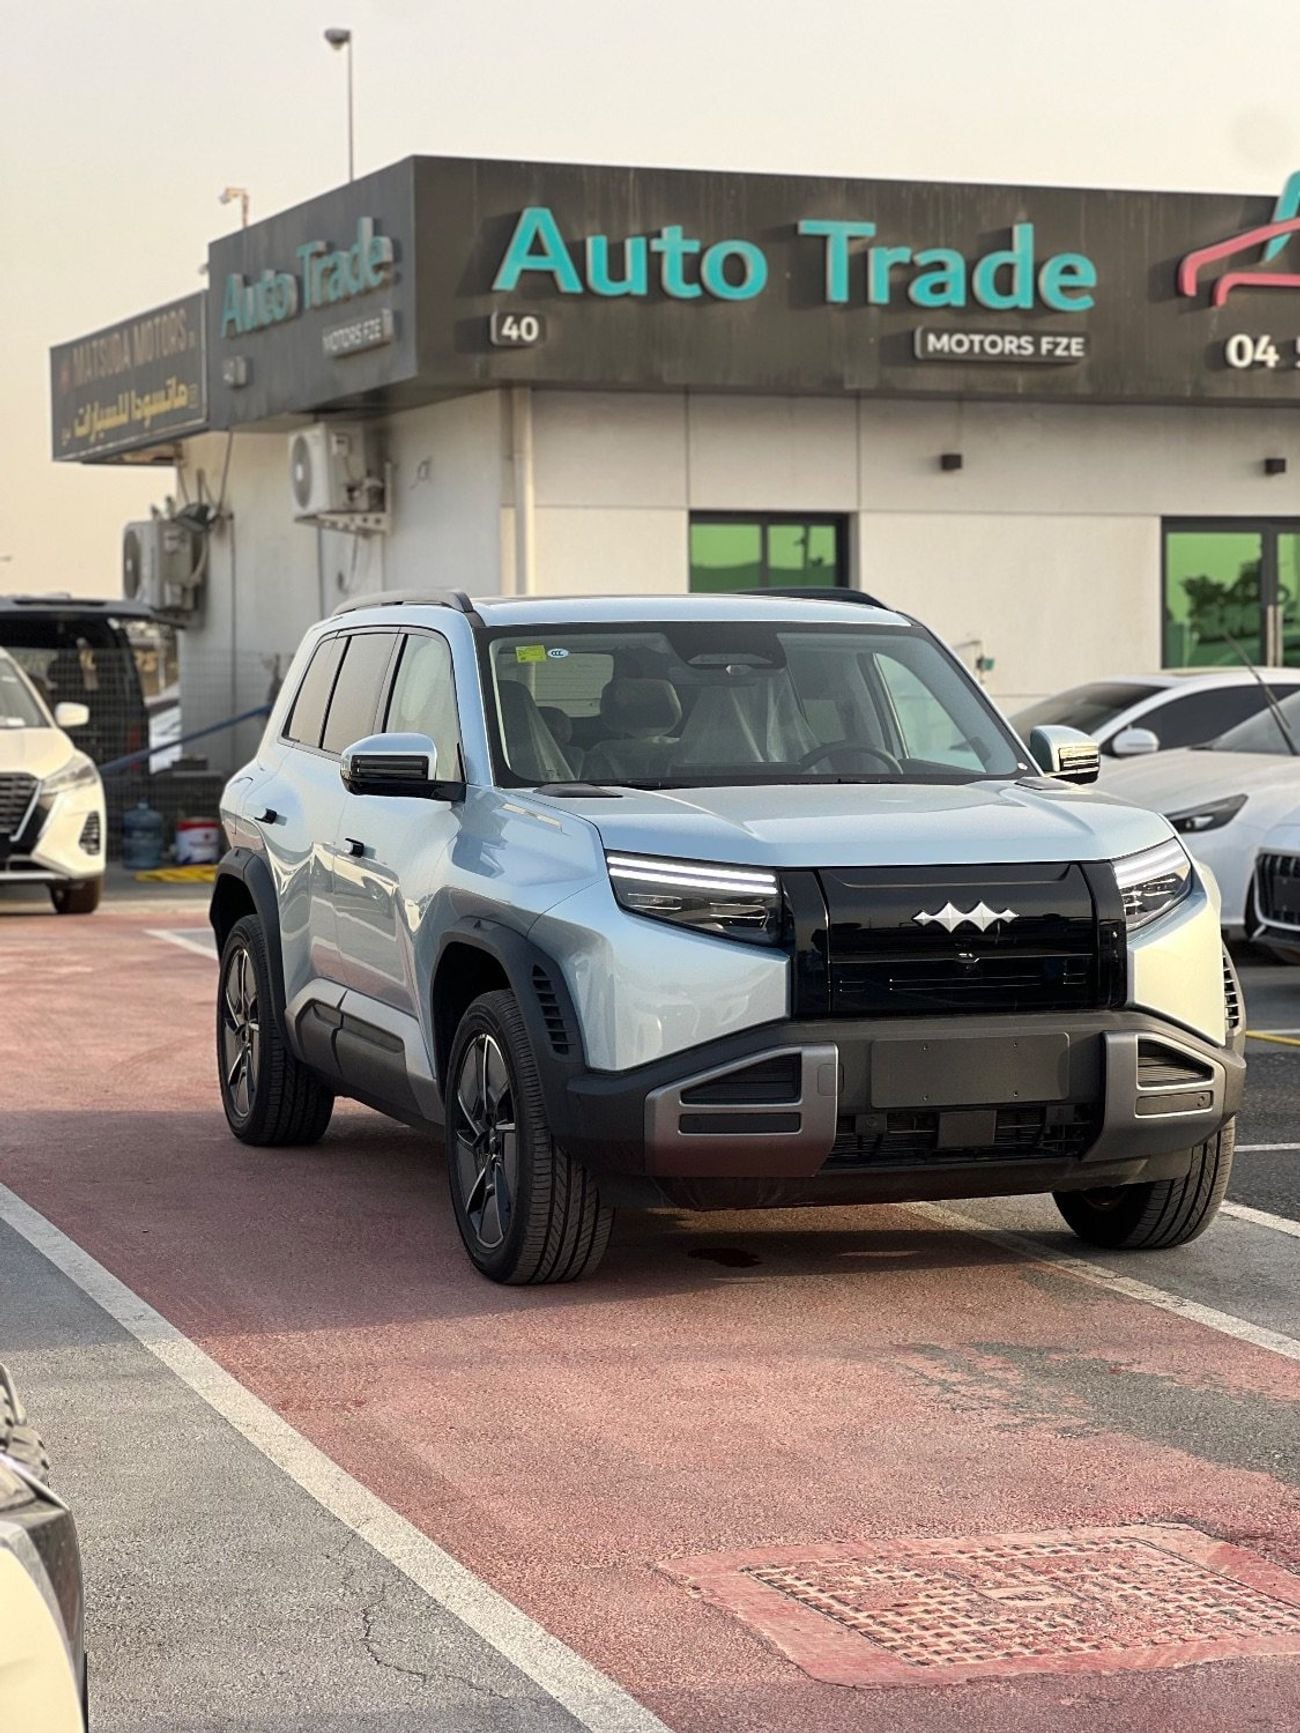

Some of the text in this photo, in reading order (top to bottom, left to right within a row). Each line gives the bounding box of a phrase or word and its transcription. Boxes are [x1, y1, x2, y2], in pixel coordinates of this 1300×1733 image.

[220, 216, 393, 338] Auto Trade
[492, 206, 1098, 312] Auto Trade
[133, 307, 187, 368] MOTORS
[501, 315, 539, 342] 40
[927, 332, 1085, 357] MOTORS FZE
[1226, 334, 1280, 368] 04
